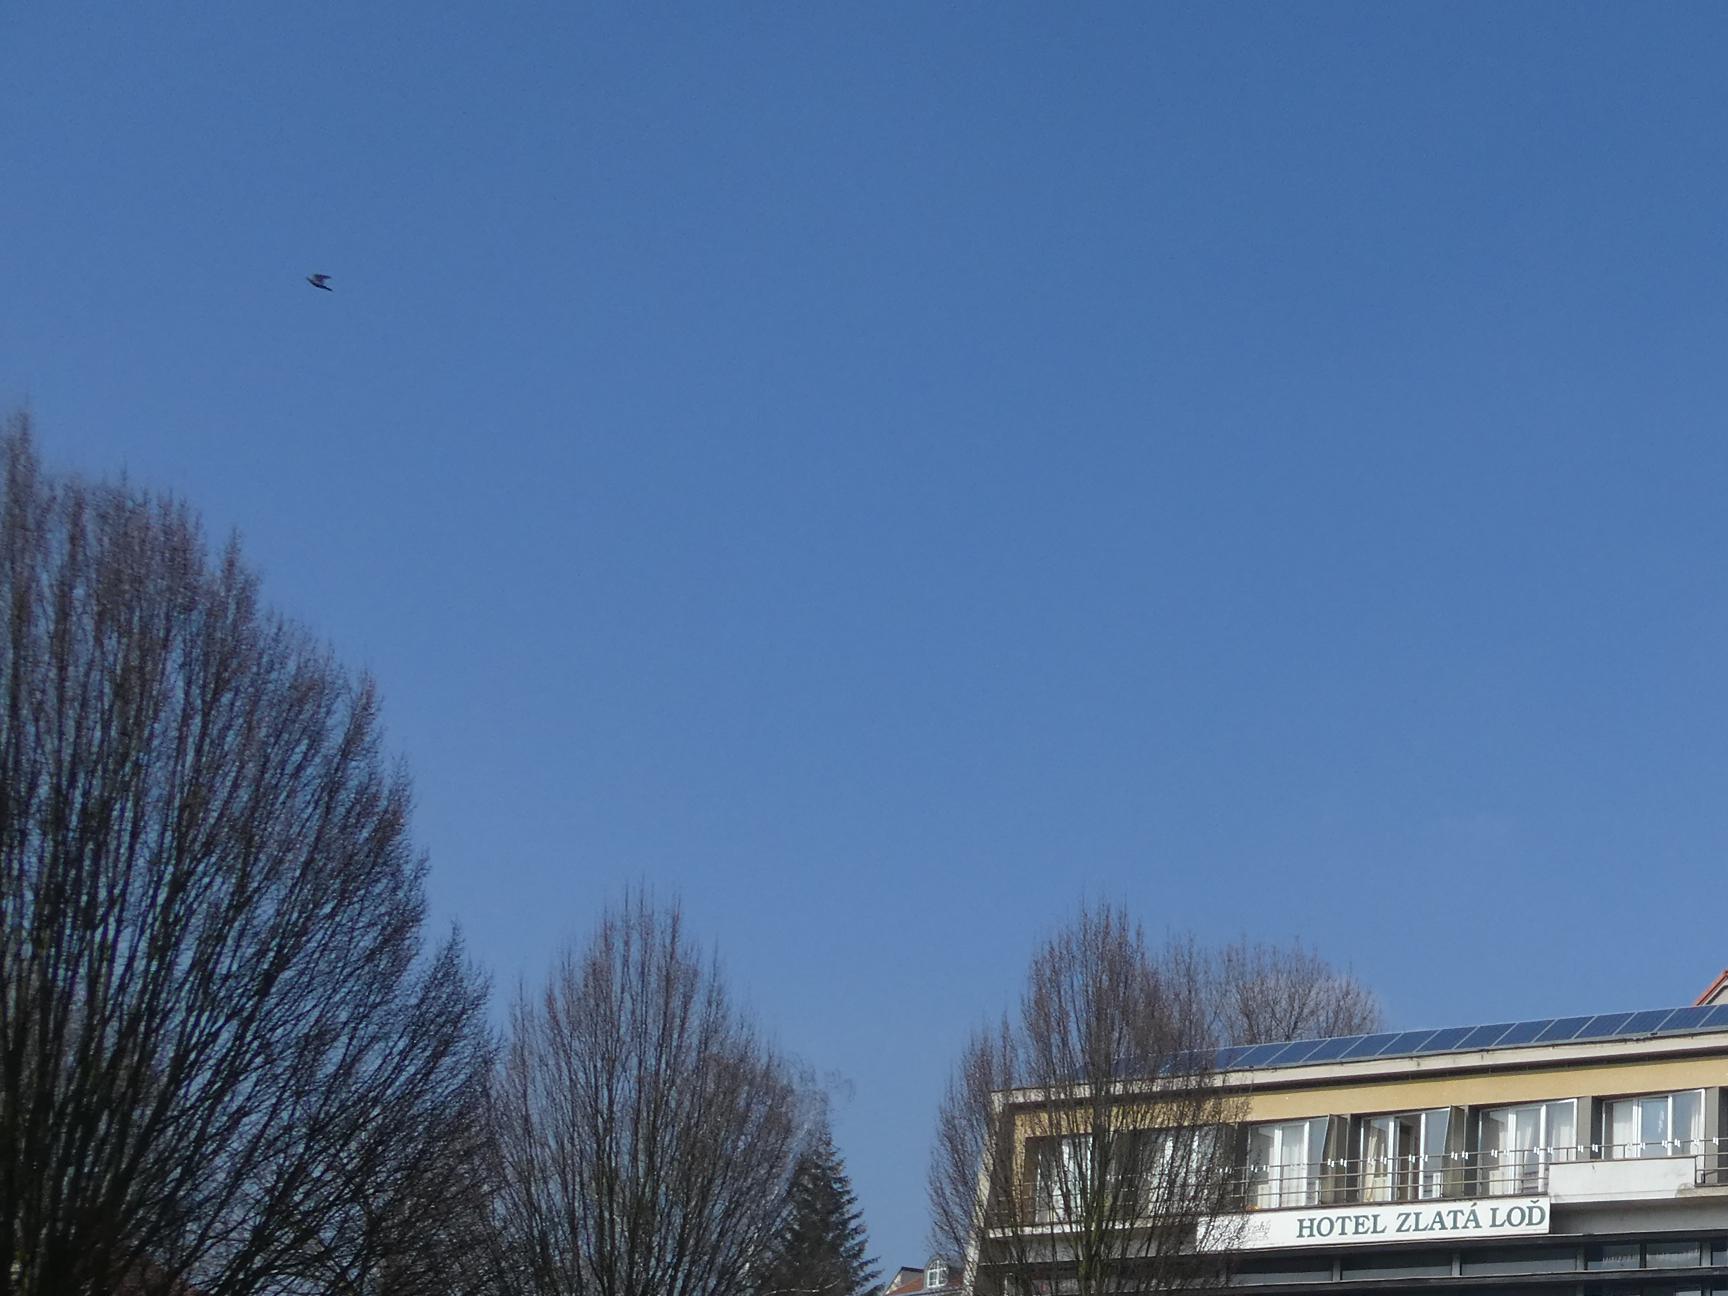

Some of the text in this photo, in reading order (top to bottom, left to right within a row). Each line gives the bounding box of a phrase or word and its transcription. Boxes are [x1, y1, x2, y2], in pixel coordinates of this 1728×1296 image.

[1296, 1214, 1387, 1238] HOTEL
[1395, 1202, 1482, 1233] ZLATÁ
[1489, 1200, 1546, 1228] LOĎ
